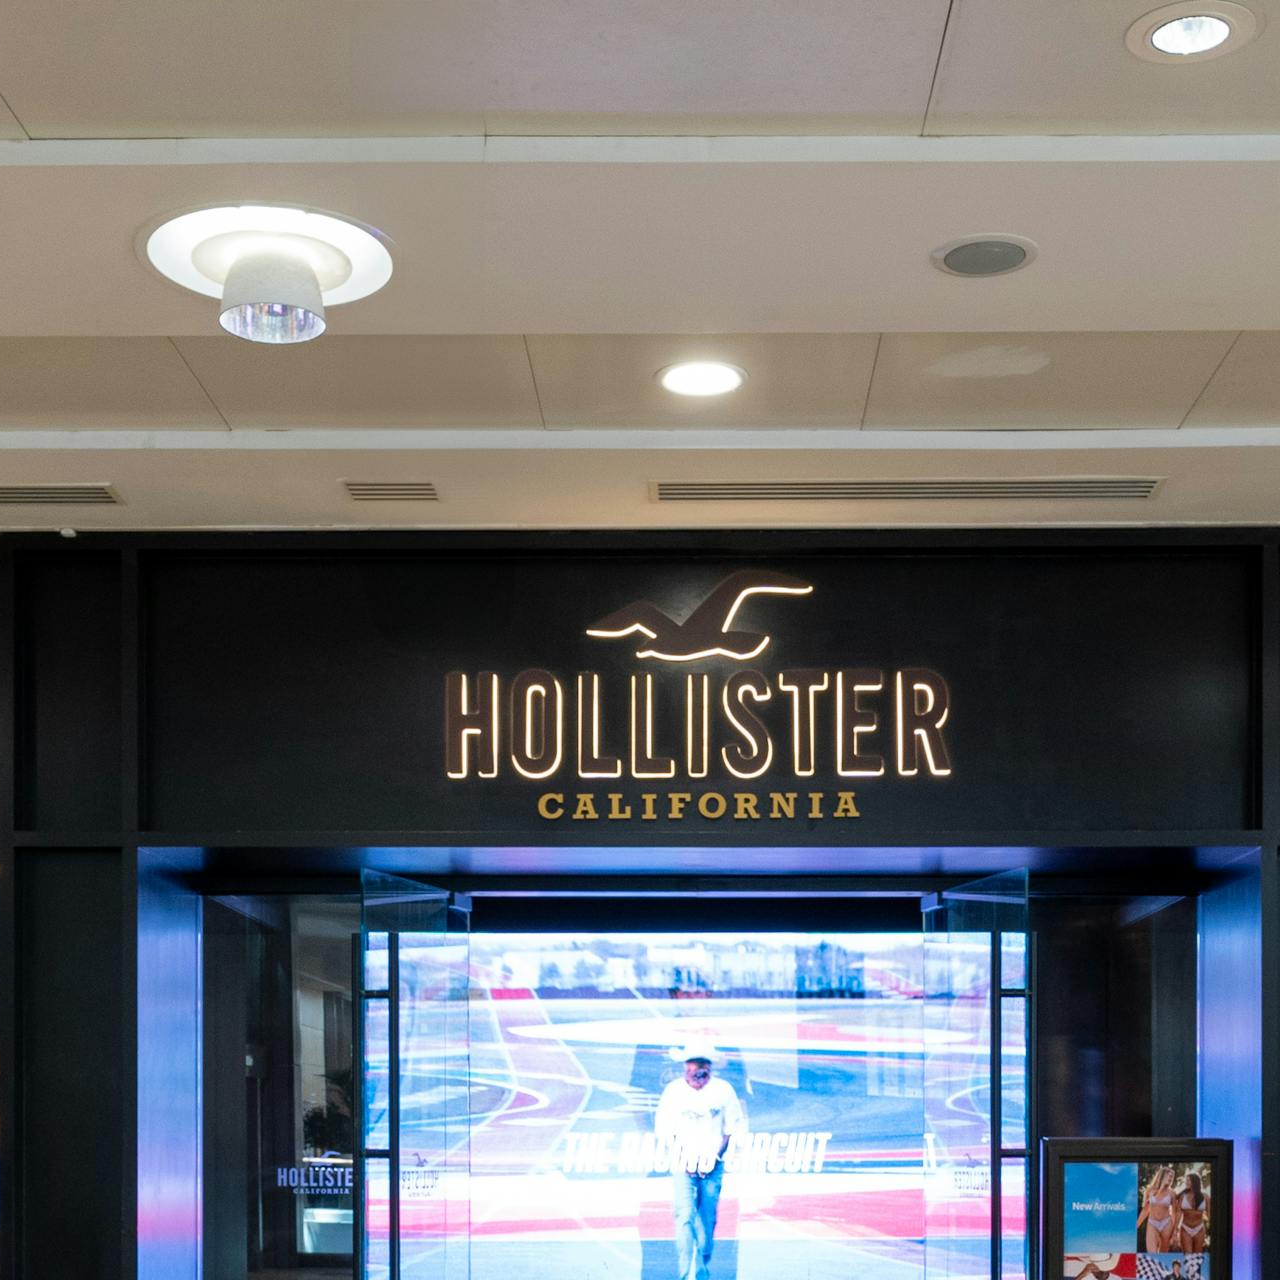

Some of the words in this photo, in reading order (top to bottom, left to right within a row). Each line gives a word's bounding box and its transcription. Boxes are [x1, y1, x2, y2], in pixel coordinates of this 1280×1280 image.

[445, 669, 952, 779] HOLLISTER
[537, 791, 861, 820] CALIFORNIA
[563, 1132, 616, 1174] THE
[724, 1132, 833, 1174] CIRCUIT
[293, 1187, 350, 1195] CALIFORNIA
[1072, 1202, 1092, 1211] New
[1094, 1202, 1127, 1212] Arrivals
